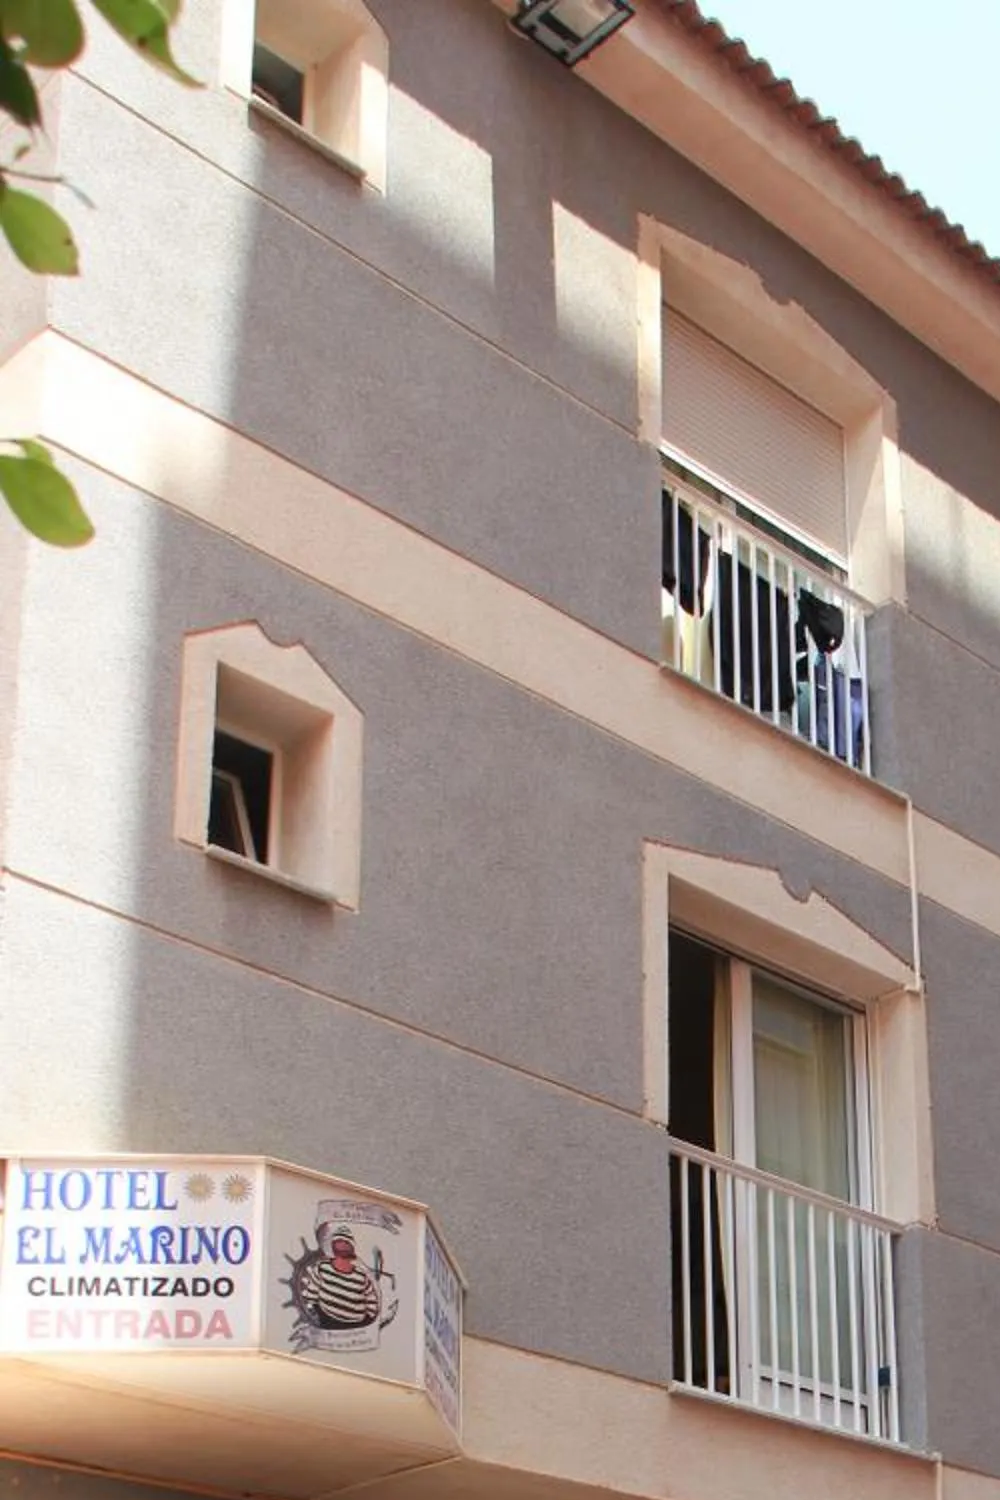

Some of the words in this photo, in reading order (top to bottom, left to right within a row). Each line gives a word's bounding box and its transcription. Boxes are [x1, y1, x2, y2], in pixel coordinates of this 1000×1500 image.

[21, 1170, 178, 1212] HOTEL
[16, 1225, 67, 1265] EL
[79, 1225, 251, 1265] MARINO
[27, 1276, 235, 1298] CLIMATIZADO
[26, 1308, 234, 1340] ENTRADA
